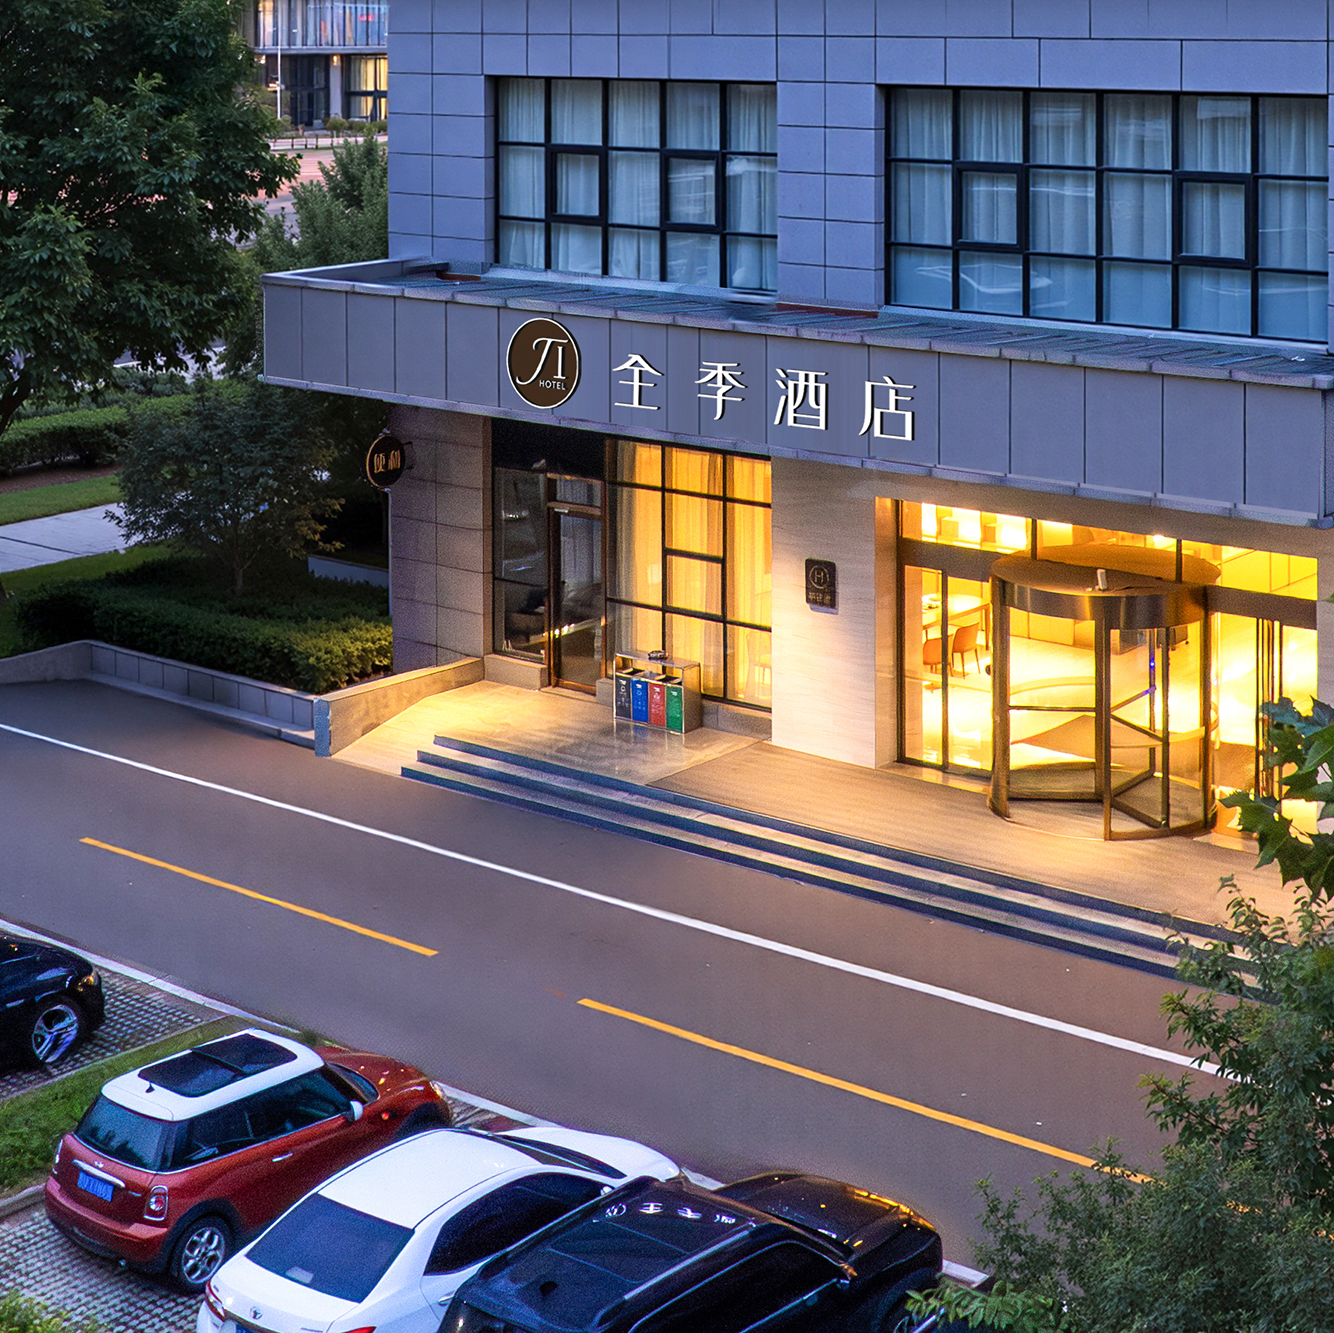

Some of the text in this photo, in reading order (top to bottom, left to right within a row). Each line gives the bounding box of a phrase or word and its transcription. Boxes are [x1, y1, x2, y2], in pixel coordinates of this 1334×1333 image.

[538, 379, 567, 391] HOTEL
[612, 353, 915, 441] 全季酒店
